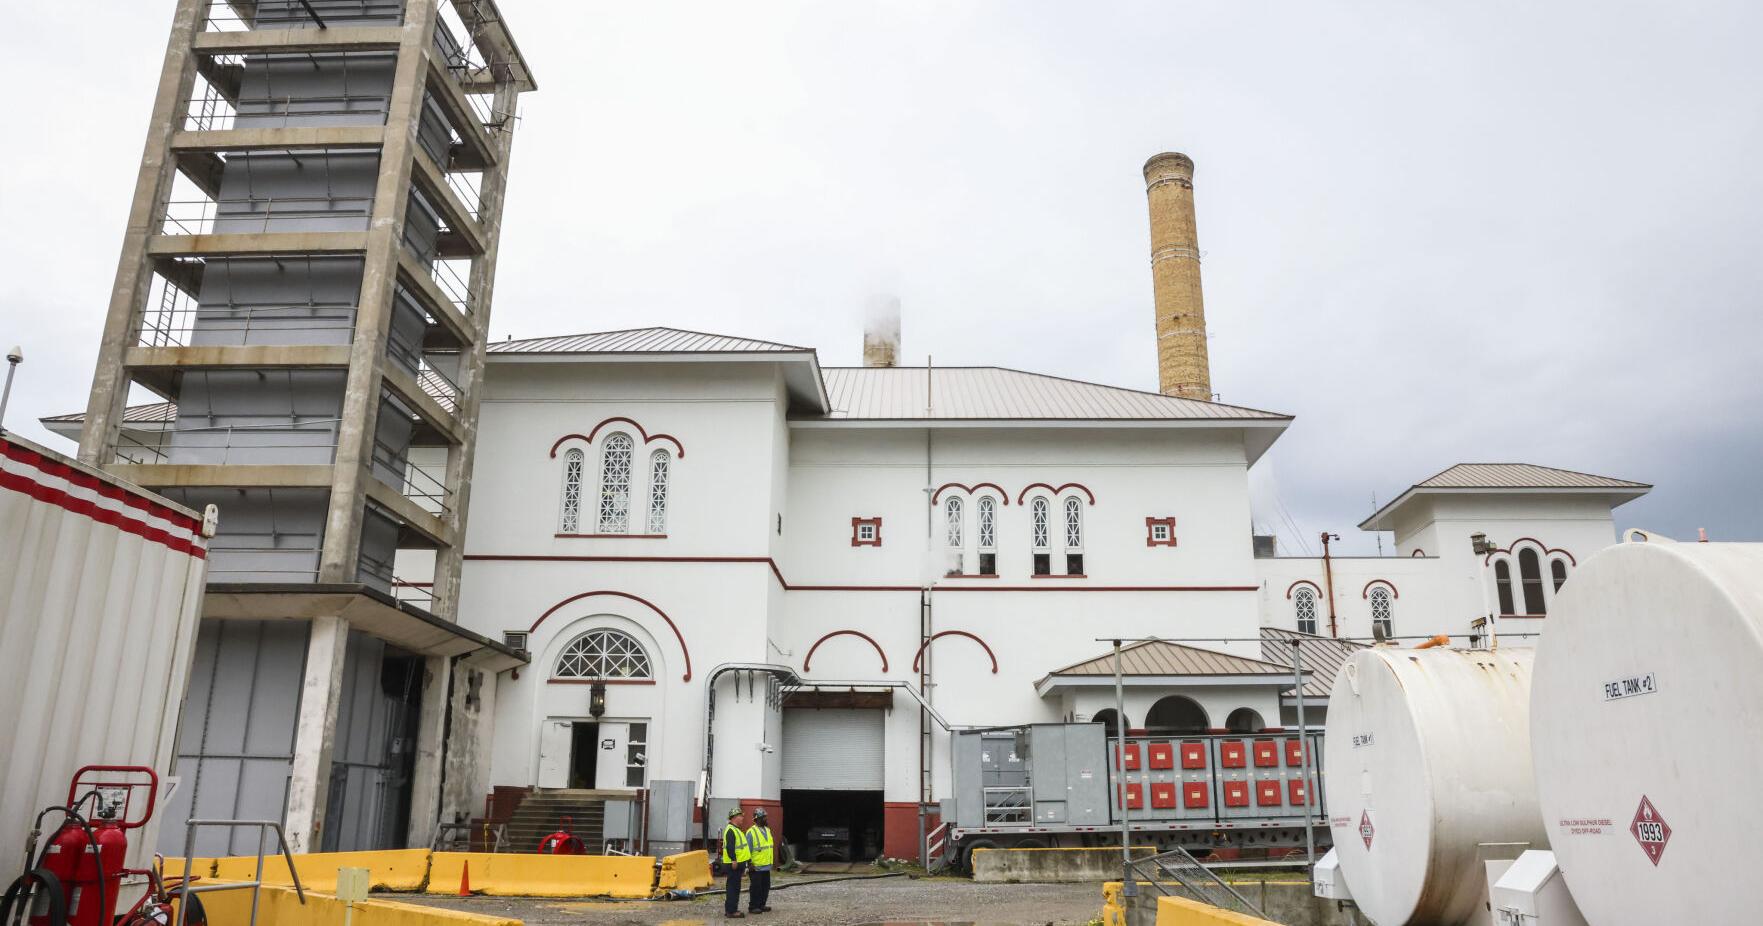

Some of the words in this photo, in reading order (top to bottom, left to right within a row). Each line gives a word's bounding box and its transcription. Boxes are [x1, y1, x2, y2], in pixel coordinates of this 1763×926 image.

[1605, 682, 1622, 698] FUEL
[1622, 678, 1642, 695] TANK
[1642, 675, 1653, 691] #2
[1639, 823, 1662, 841] 1993
